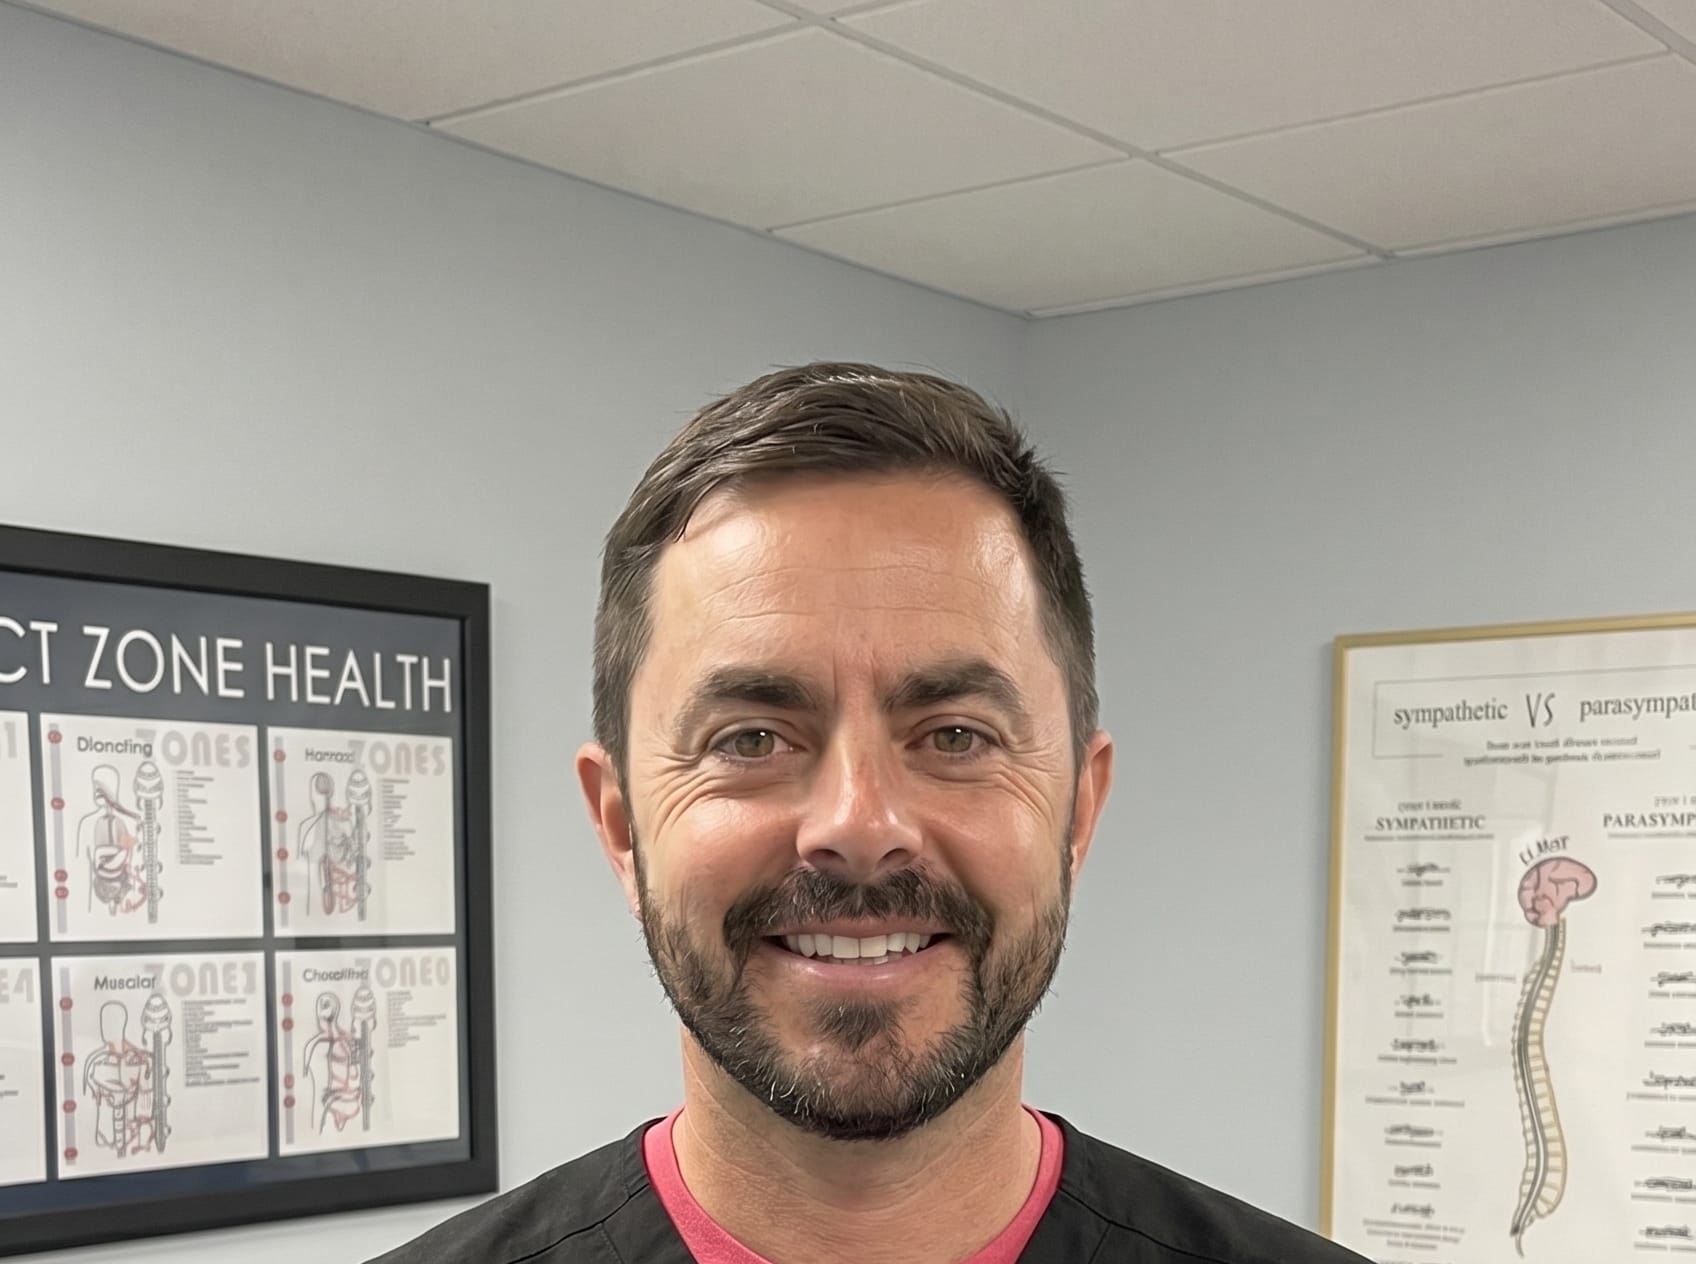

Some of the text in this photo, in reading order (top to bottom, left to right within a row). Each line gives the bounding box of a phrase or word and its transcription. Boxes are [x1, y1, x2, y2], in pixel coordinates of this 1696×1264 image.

[83, 626, 245, 699] ZONE
[266, 642, 452, 713] HEALTH
[1393, 697, 1509, 730] sympathetic
[1525, 692, 1556, 728] VS
